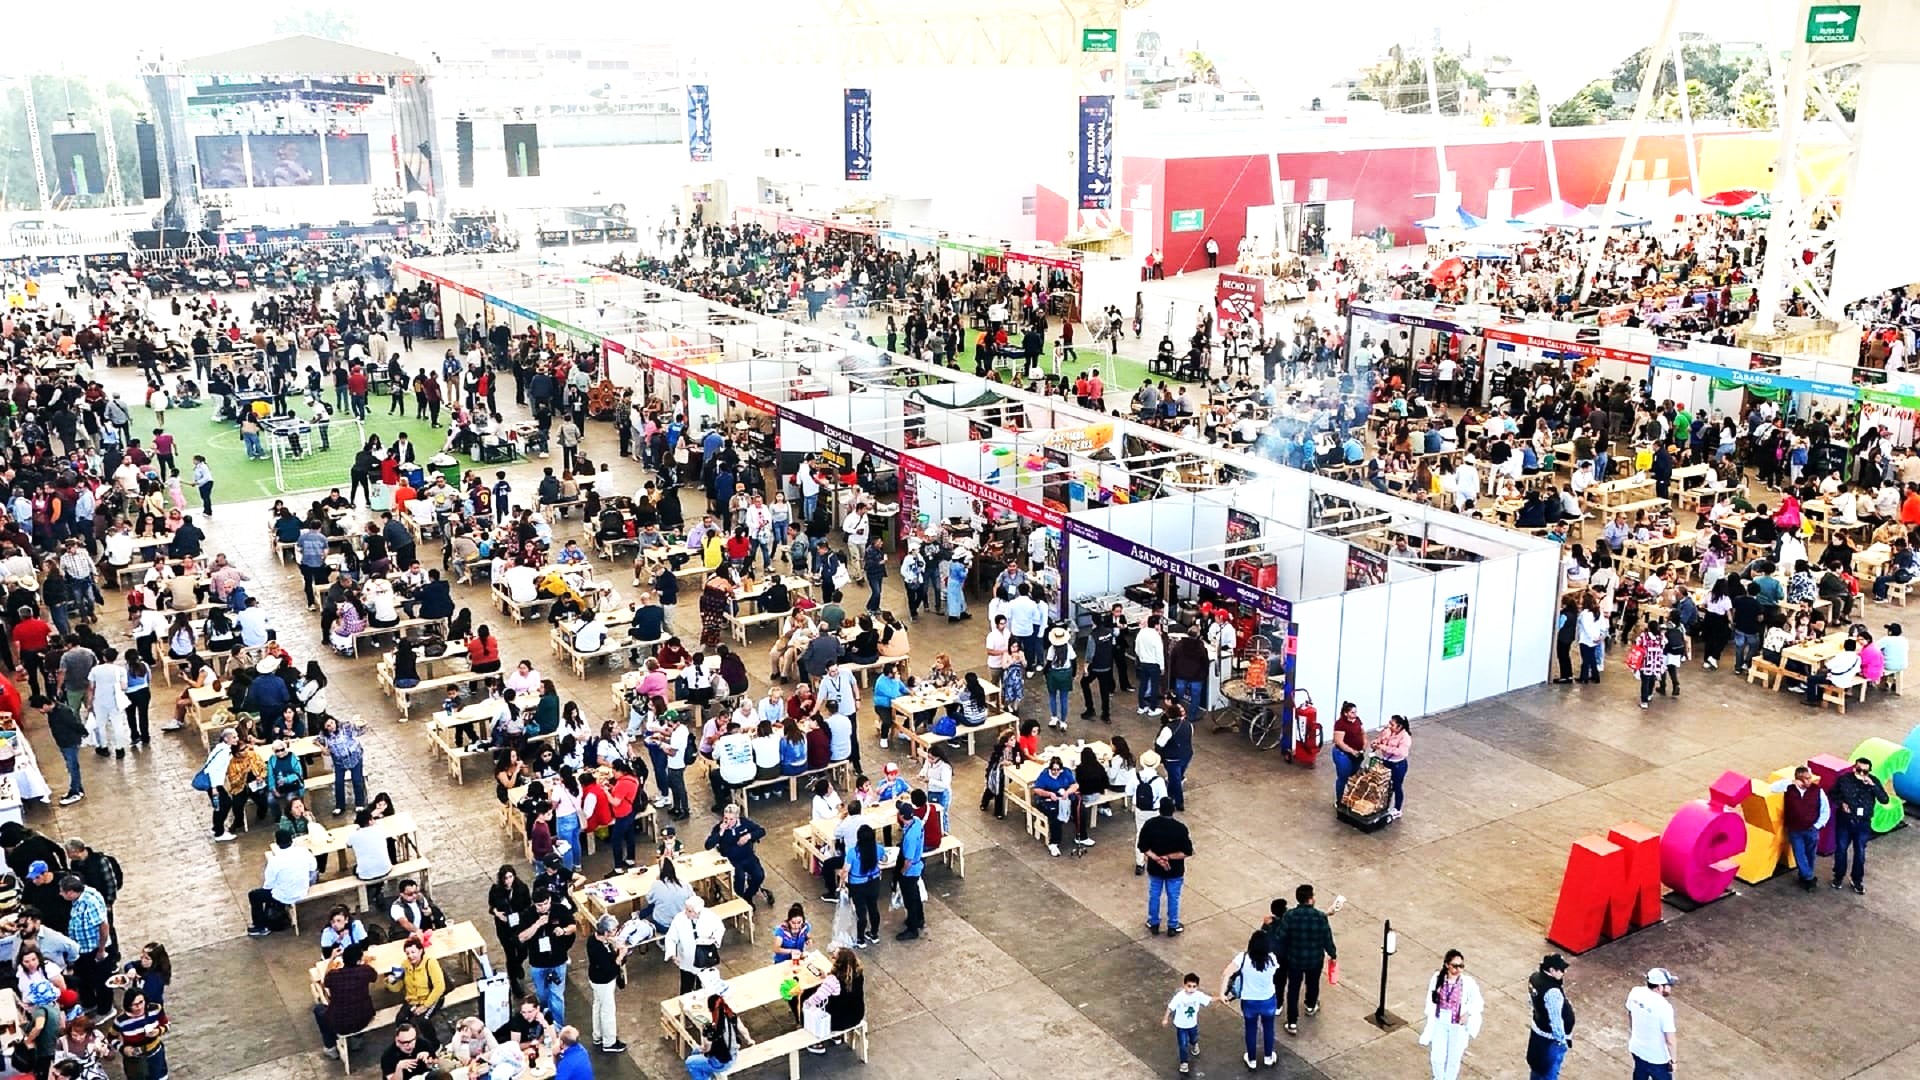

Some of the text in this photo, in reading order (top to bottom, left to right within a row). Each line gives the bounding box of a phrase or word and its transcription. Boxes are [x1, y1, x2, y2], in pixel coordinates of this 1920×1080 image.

[1086, 122, 1096, 174] PABELLÓN
[1097, 119, 1105, 177] ARTESANAL
[1527, 337, 1607, 356] BAJA CALIFORNIA SUR
[1732, 371, 1772, 384] TABASCO
[480, 494, 489, 505] 9
[947, 473, 1014, 508] TULA DE ALLENDE
[1130, 544, 1220, 589] ASADOS EL NEGRO
